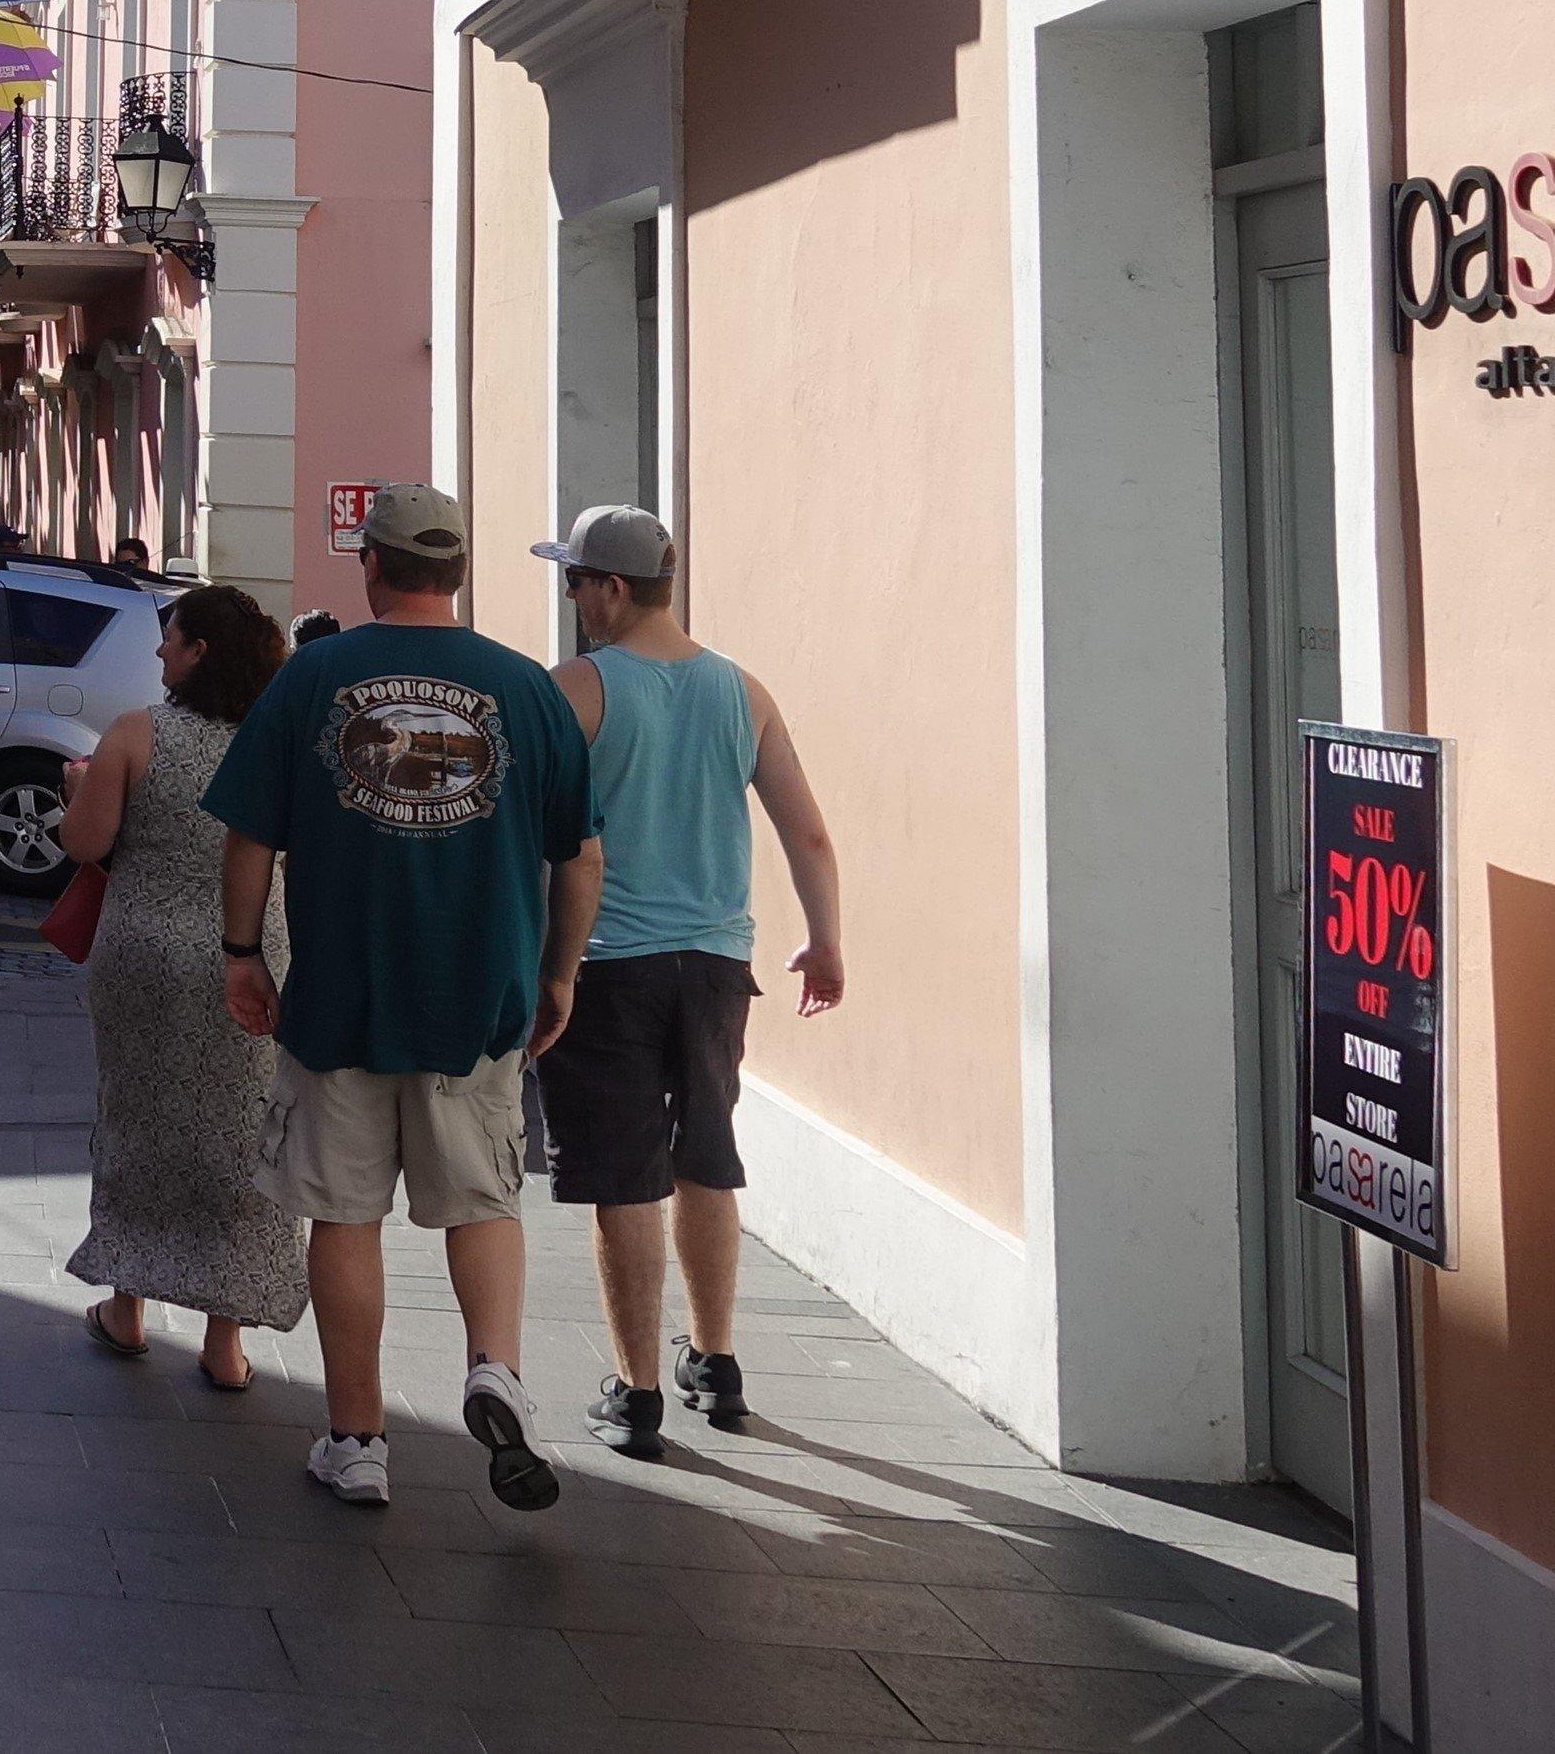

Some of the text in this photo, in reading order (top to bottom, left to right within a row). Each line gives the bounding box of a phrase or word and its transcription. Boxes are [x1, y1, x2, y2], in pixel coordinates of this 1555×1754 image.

[334, 490, 357, 525] SE
[352, 680, 479, 713] POQUOSON
[1328, 742, 1423, 789] CLEARANCE
[353, 787, 479, 823] SEAFOOD FESTIVAL
[1353, 803, 1395, 843] SALE
[1326, 849, 1433, 981] 50%
[1357, 980, 1389, 1019] OFF
[1343, 1032, 1402, 1085] ENTIRE
[1345, 1092, 1398, 1144] STORE
